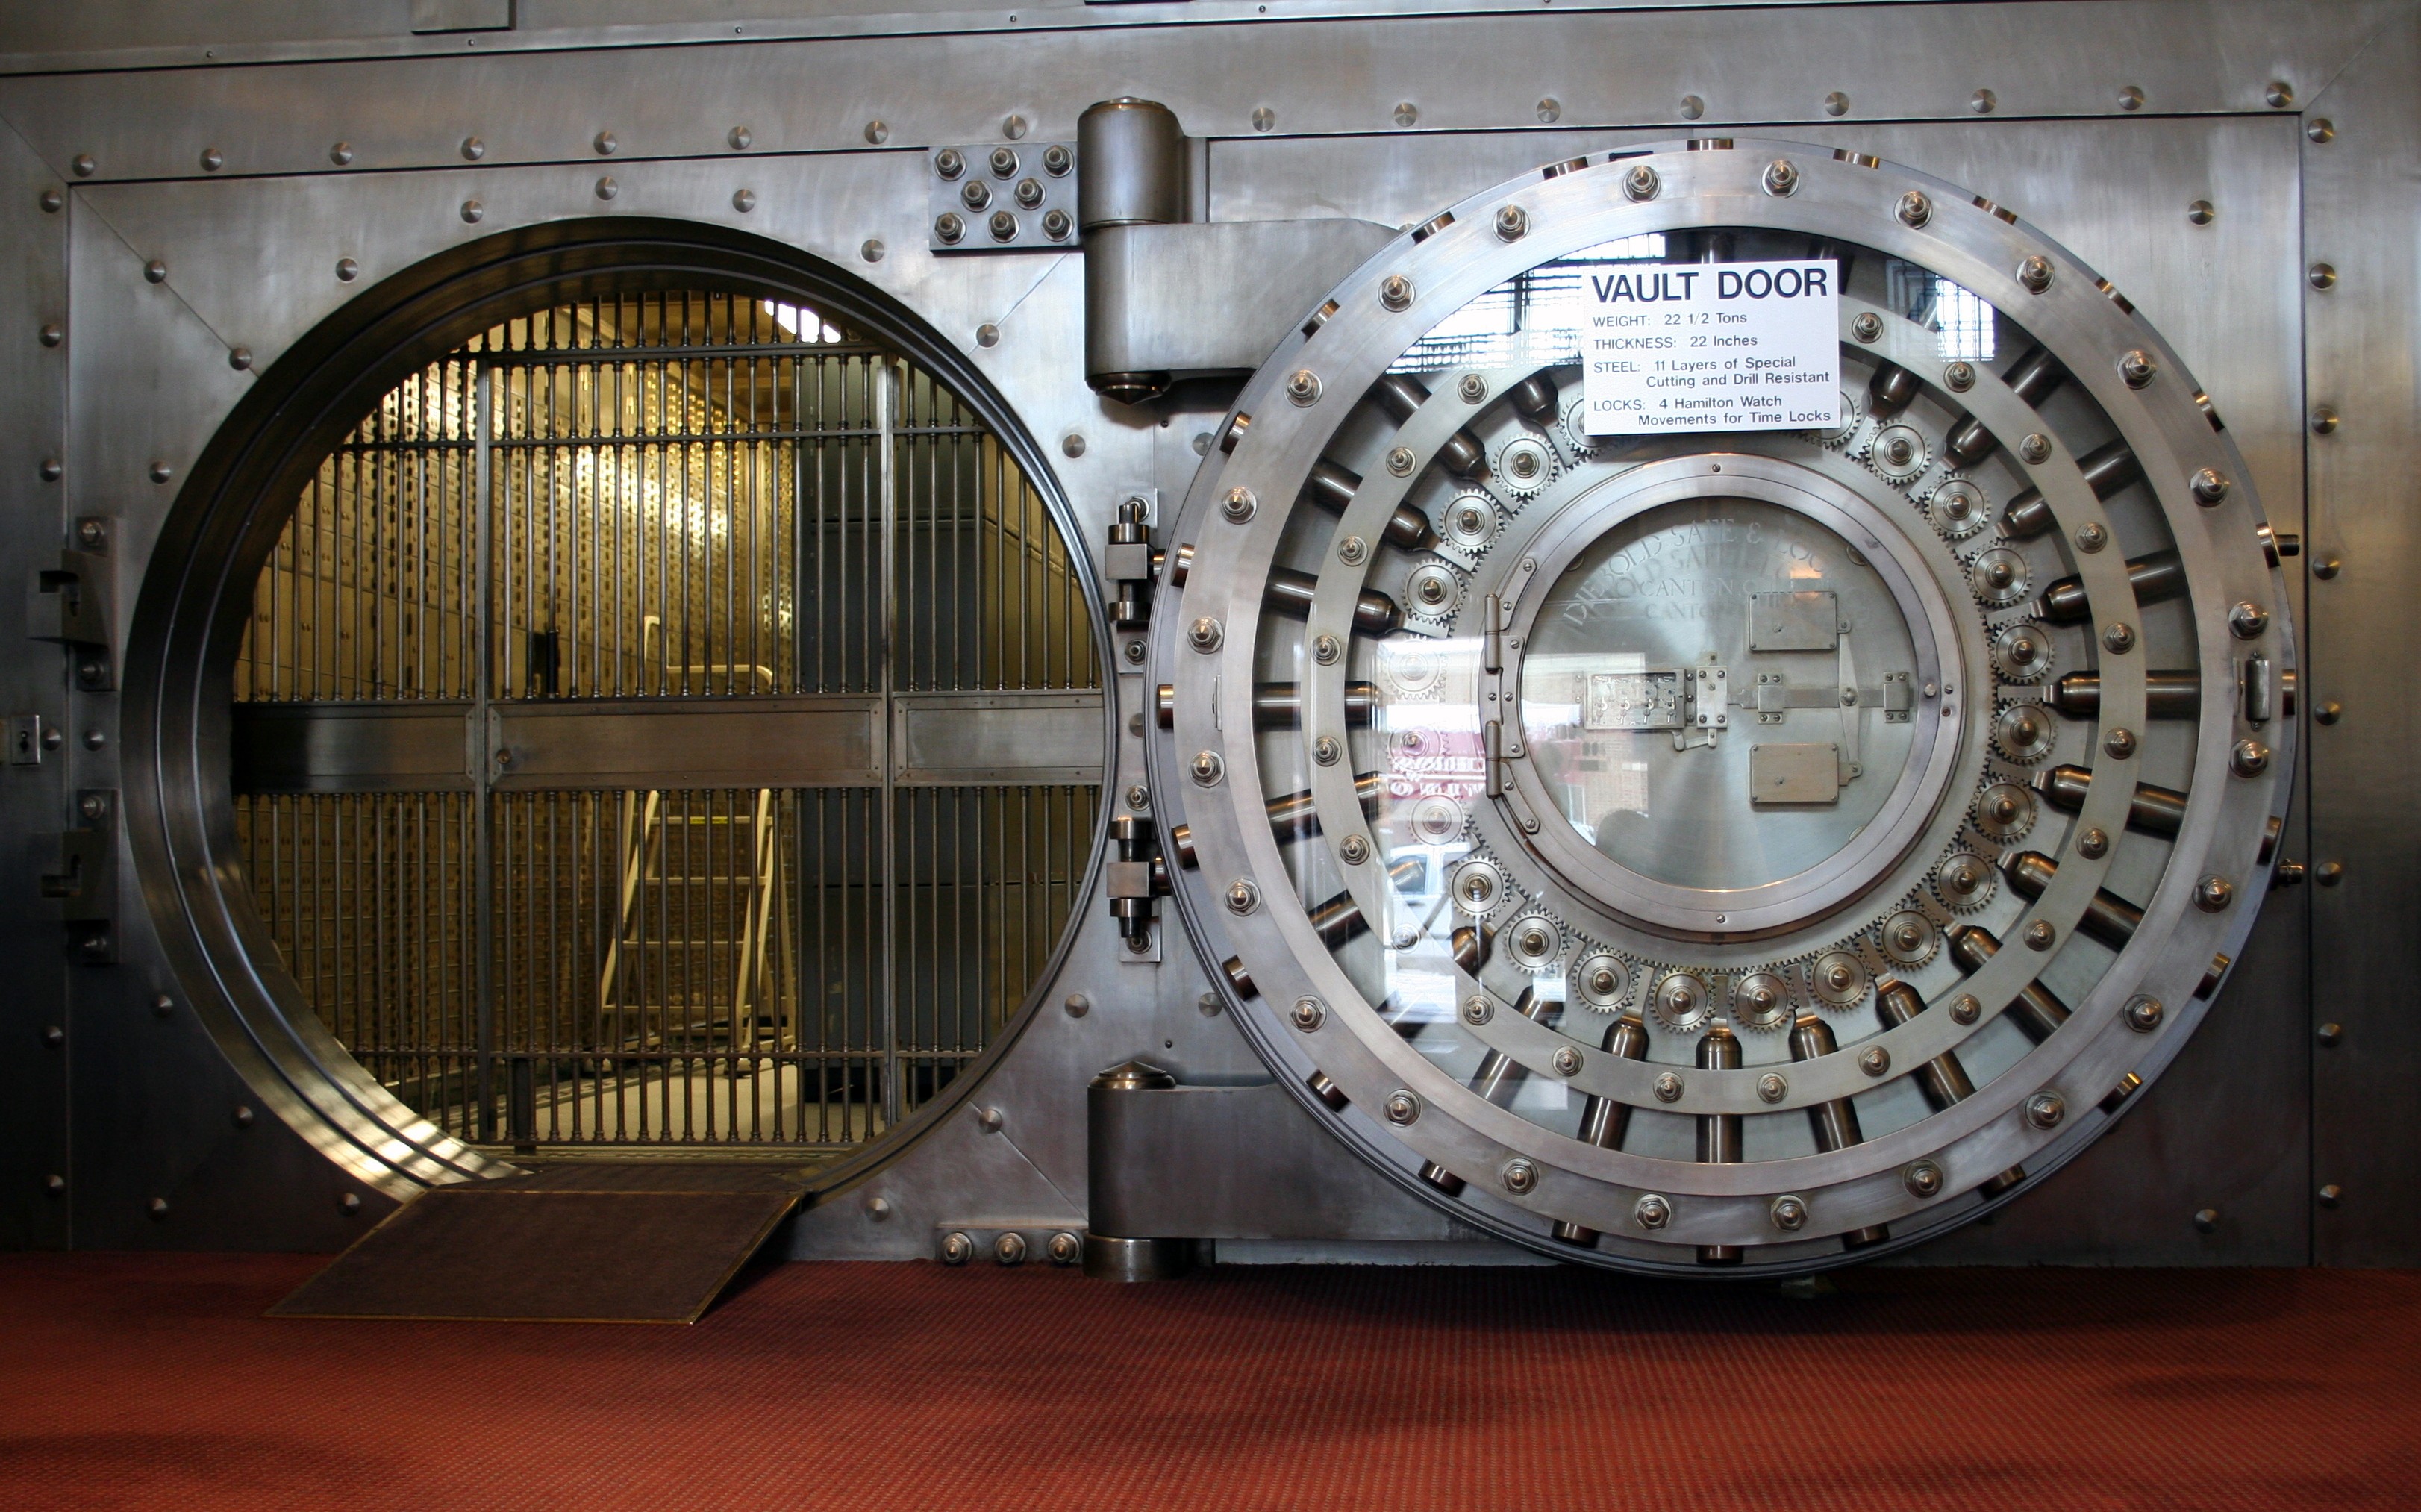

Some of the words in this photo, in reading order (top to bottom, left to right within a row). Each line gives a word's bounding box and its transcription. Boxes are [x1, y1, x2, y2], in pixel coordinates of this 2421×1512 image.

[1592, 272, 1699, 302] VAULT
[1718, 268, 1827, 299] DOOR
[1593, 316, 1650, 326] WEIGHT:
[1665, 314, 1680, 325] 22
[1688, 313, 1708, 323] 1/2
[1716, 313, 1746, 323] Tons
[1594, 337, 1676, 349] THICKNESS:
[1691, 336, 1706, 346] 22
[1714, 335, 1758, 346] Inches
[1595, 362, 1640, 372] STEEL:
[1655, 361, 1664, 370] 11
[1672, 360, 1716, 372] Layers
[1725, 358, 1737, 369] of
[1746, 356, 1795, 370] Special
[1647, 377, 1695, 388] Cutting
[1702, 375, 1726, 385] and
[1734, 374, 1758, 384] Drill
[1766, 372, 1829, 384] Resistant
[1594, 399, 1646, 410] LOCKS:
[1660, 399, 1667, 408] 4
[1675, 398, 1733, 408] Hamilton
[1740, 396, 1781, 407] Watch
[1639, 414, 1716, 425] Movements
[1724, 413, 1742, 423] for
[1749, 412, 1781, 422] Time
[1790, 410, 1831, 422] Locks
